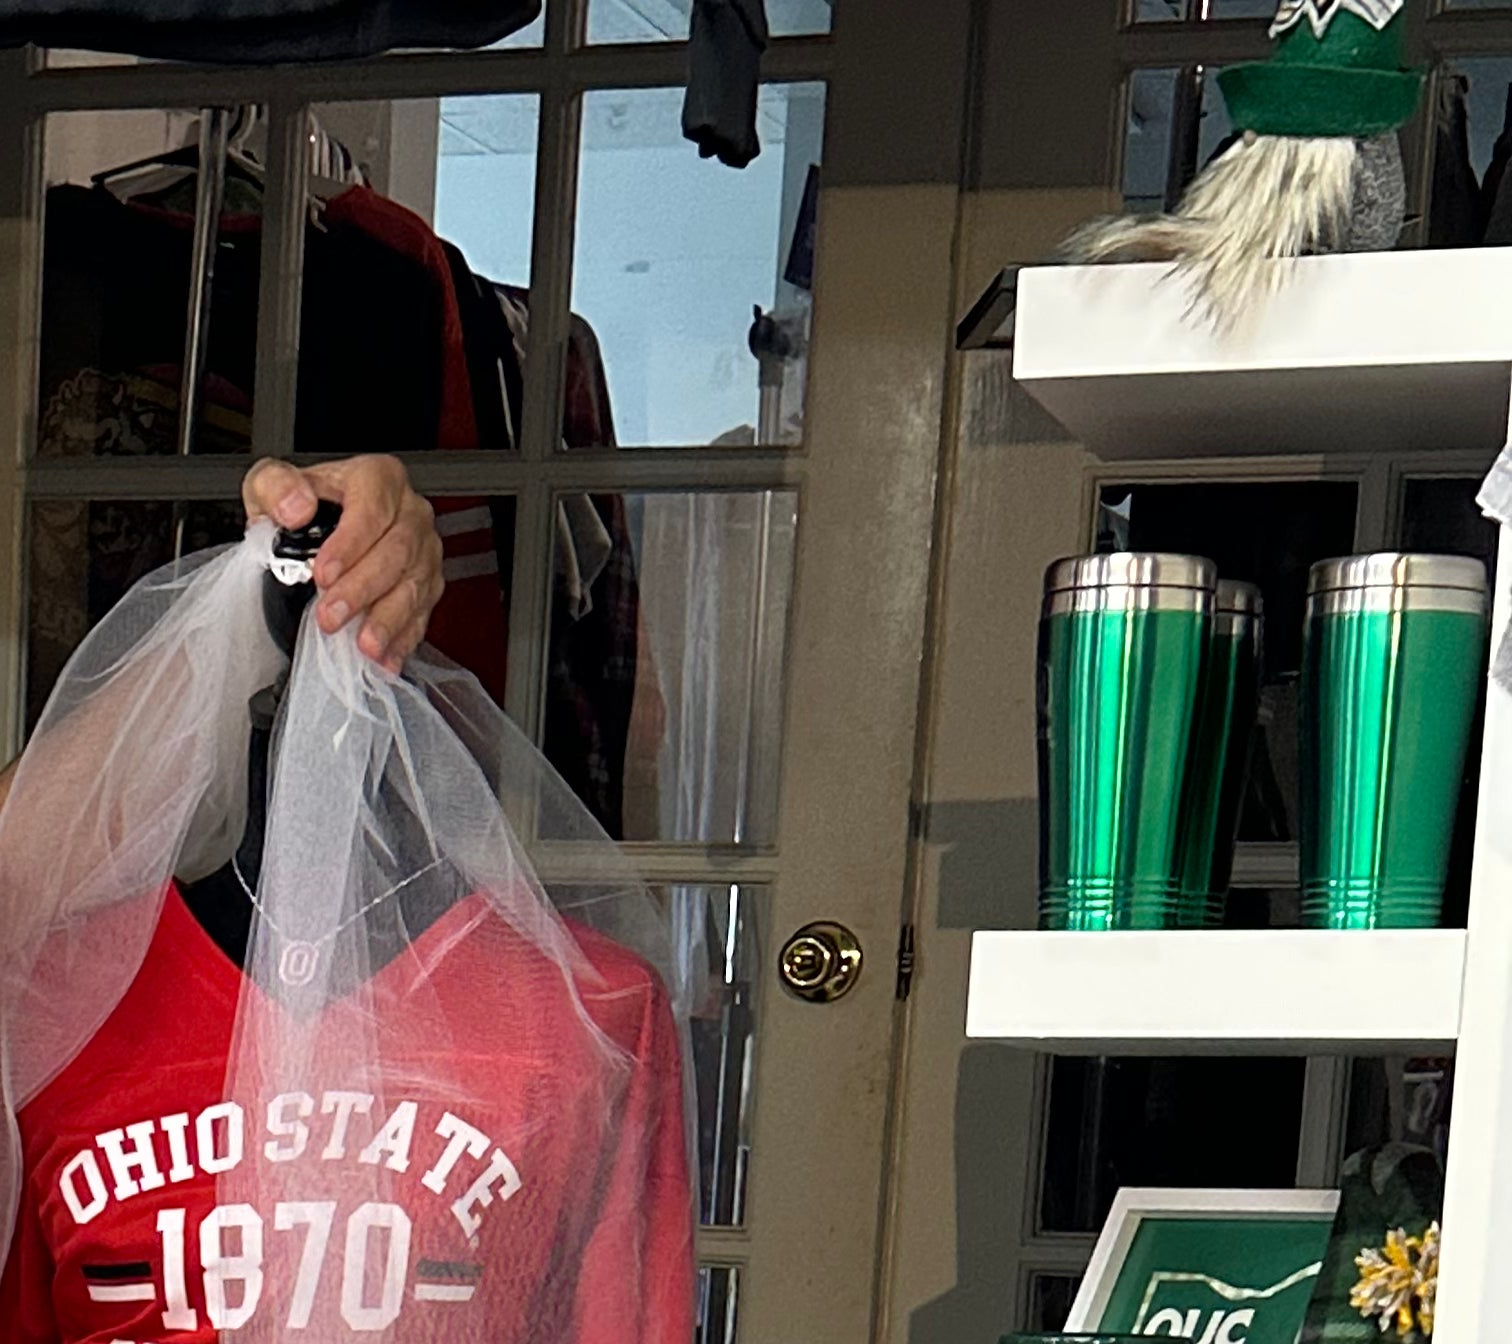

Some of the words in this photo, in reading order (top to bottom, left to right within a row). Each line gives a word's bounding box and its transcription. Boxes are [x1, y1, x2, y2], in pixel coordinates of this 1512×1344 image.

[59, 1101, 244, 1224] OHIO
[264, 1091, 523, 1238] STATE
[156, 1201, 412, 1331] 1870
